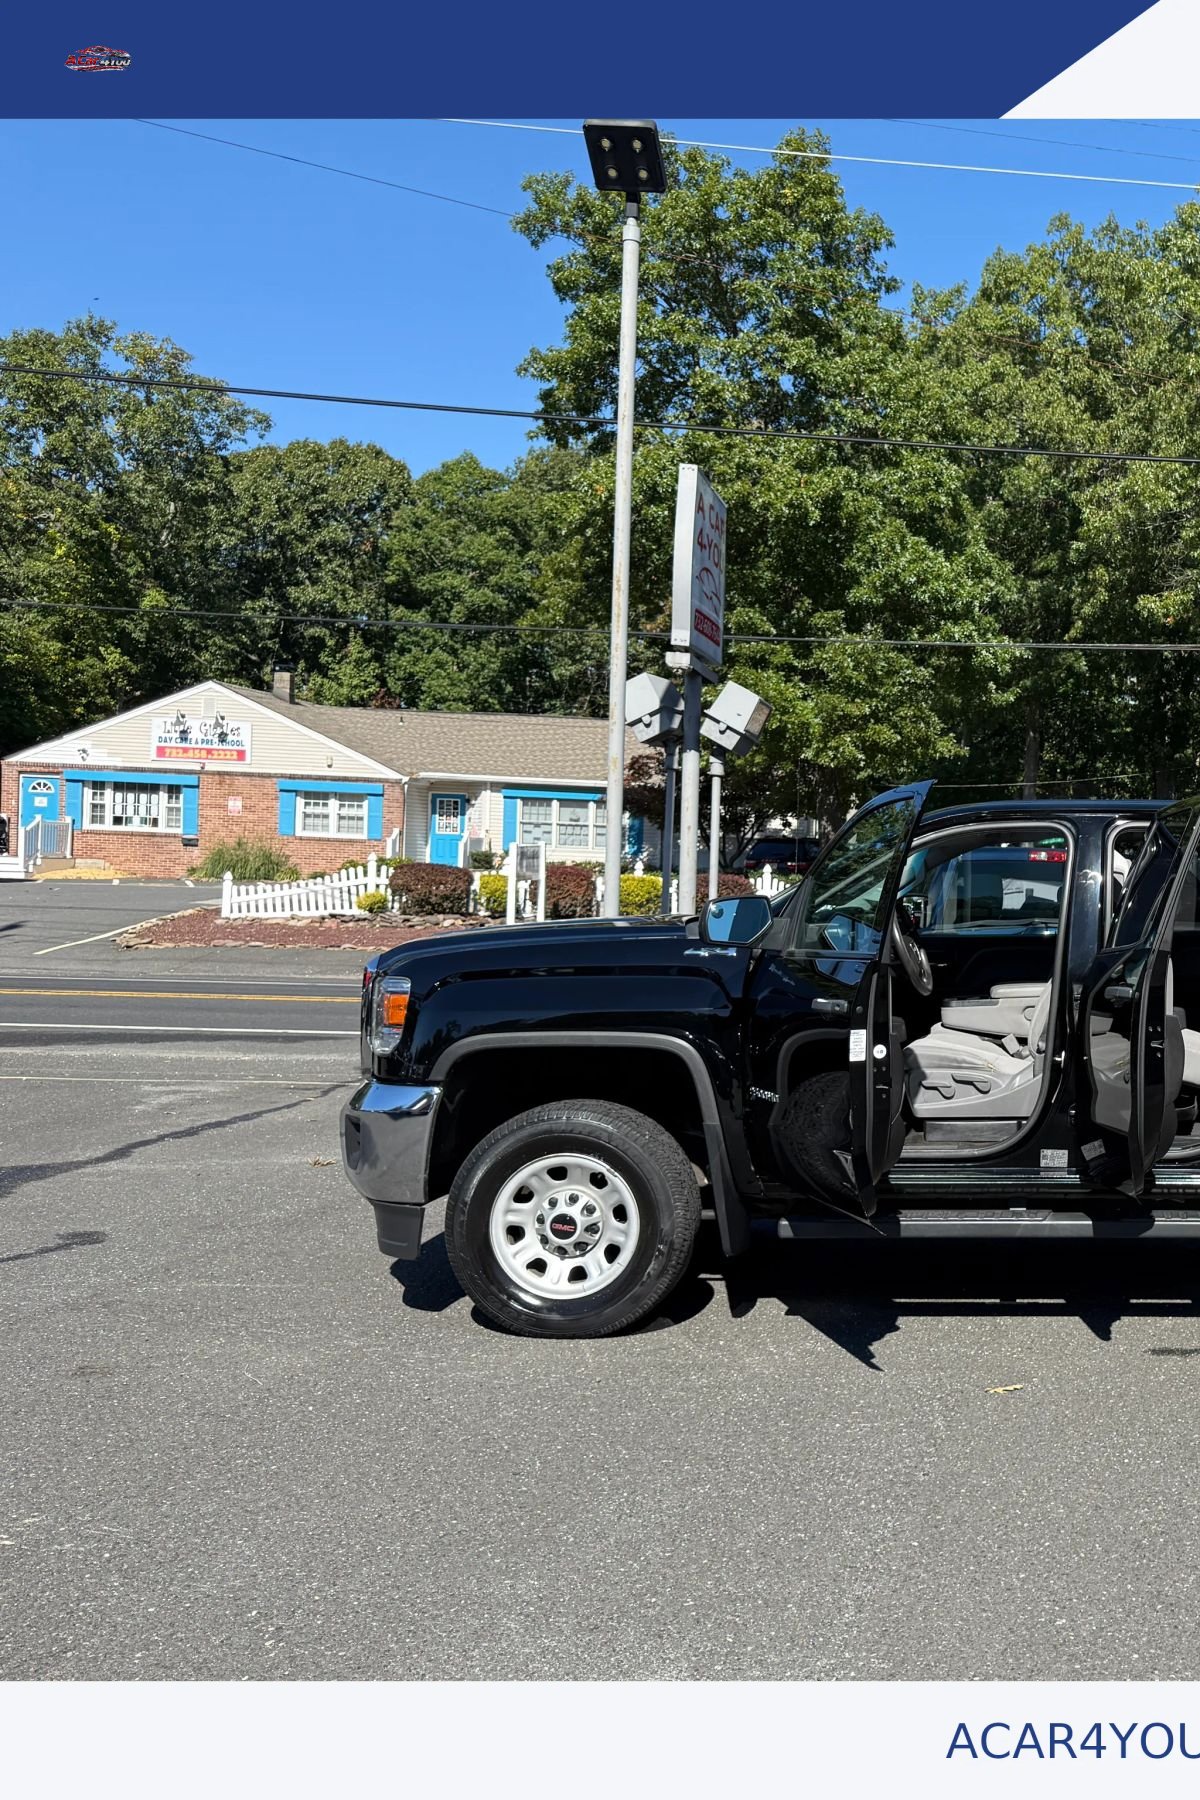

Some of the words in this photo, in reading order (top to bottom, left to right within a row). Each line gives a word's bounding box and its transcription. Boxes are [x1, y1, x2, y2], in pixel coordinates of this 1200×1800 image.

[696, 494, 706, 521] A
[158, 735, 174, 744] DAY
[551, 1223, 576, 1232] GMC
